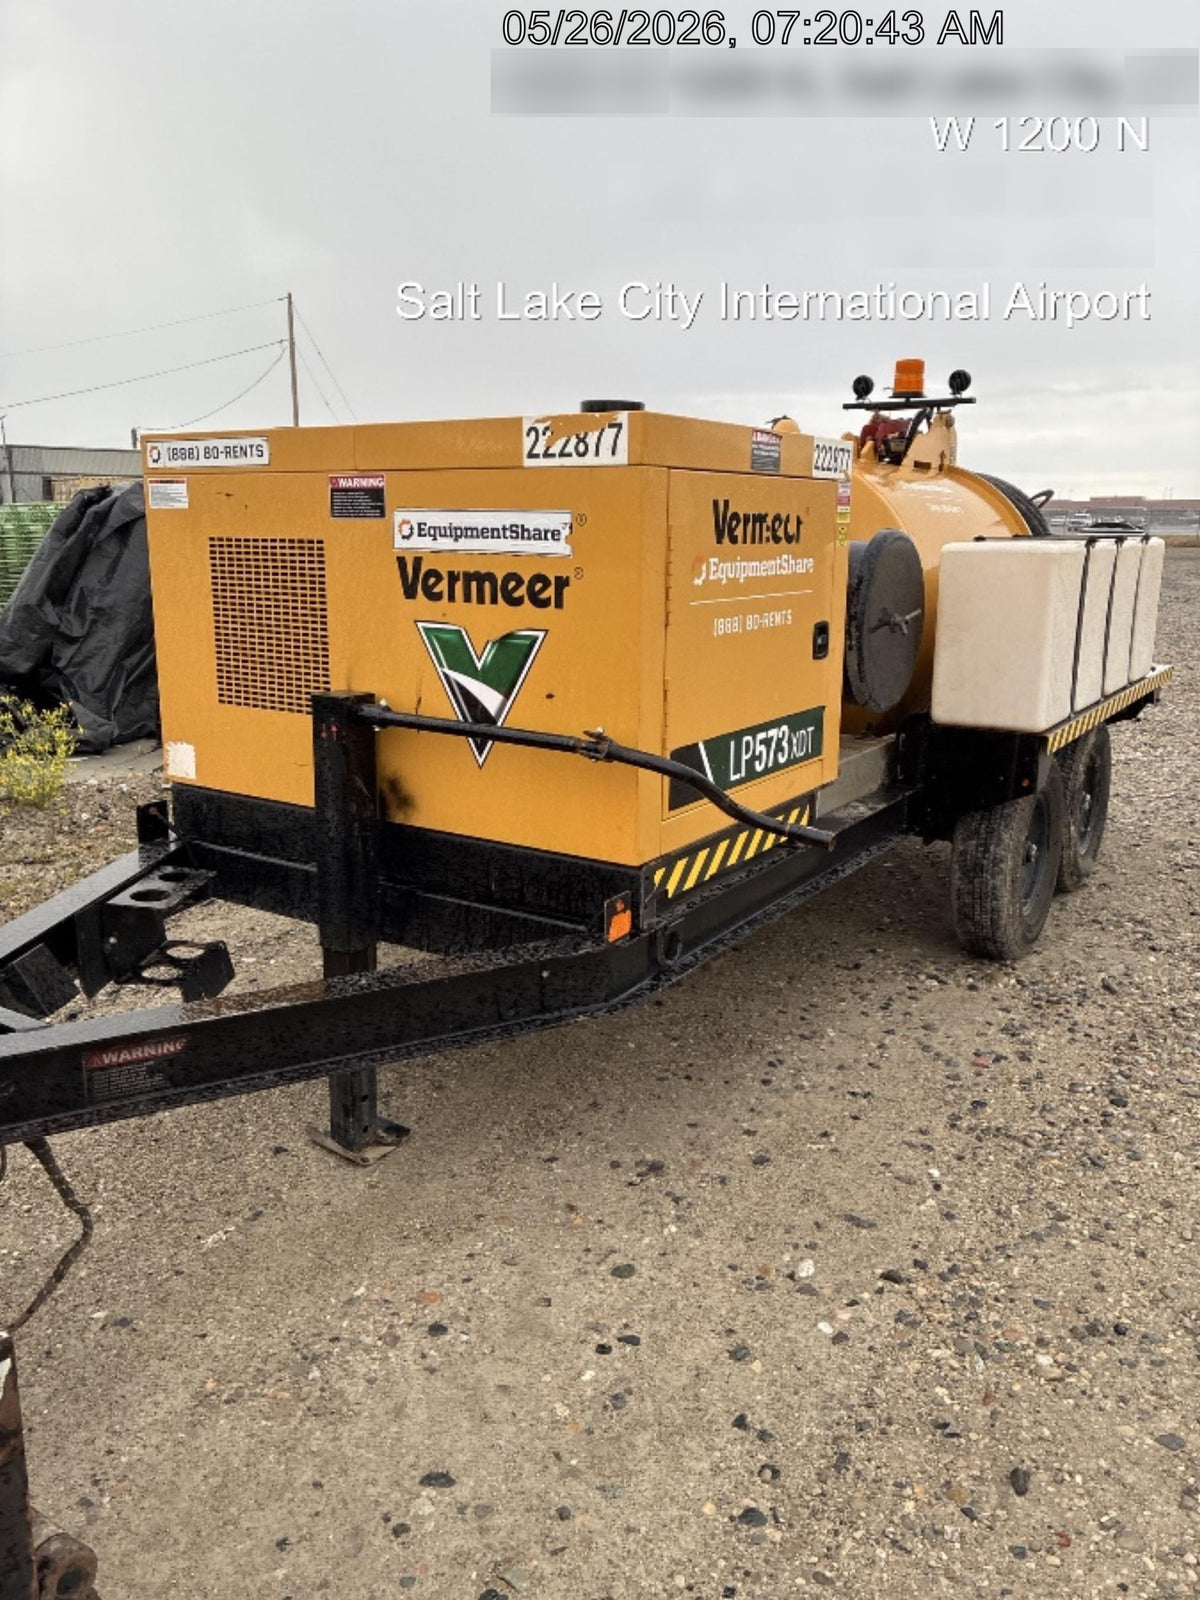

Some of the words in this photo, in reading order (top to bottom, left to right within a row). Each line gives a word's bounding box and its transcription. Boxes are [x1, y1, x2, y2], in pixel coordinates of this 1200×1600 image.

[167, 446, 200, 461] (888)
[203, 443, 264, 459] 80-RENTS
[337, 477, 384, 488] WARNING
[417, 522, 561, 541] EquipmentShare
[708, 554, 814, 585] EquipmentShare
[396, 556, 570, 610] Vermeer
[102, 1039, 187, 1064] WARNING
